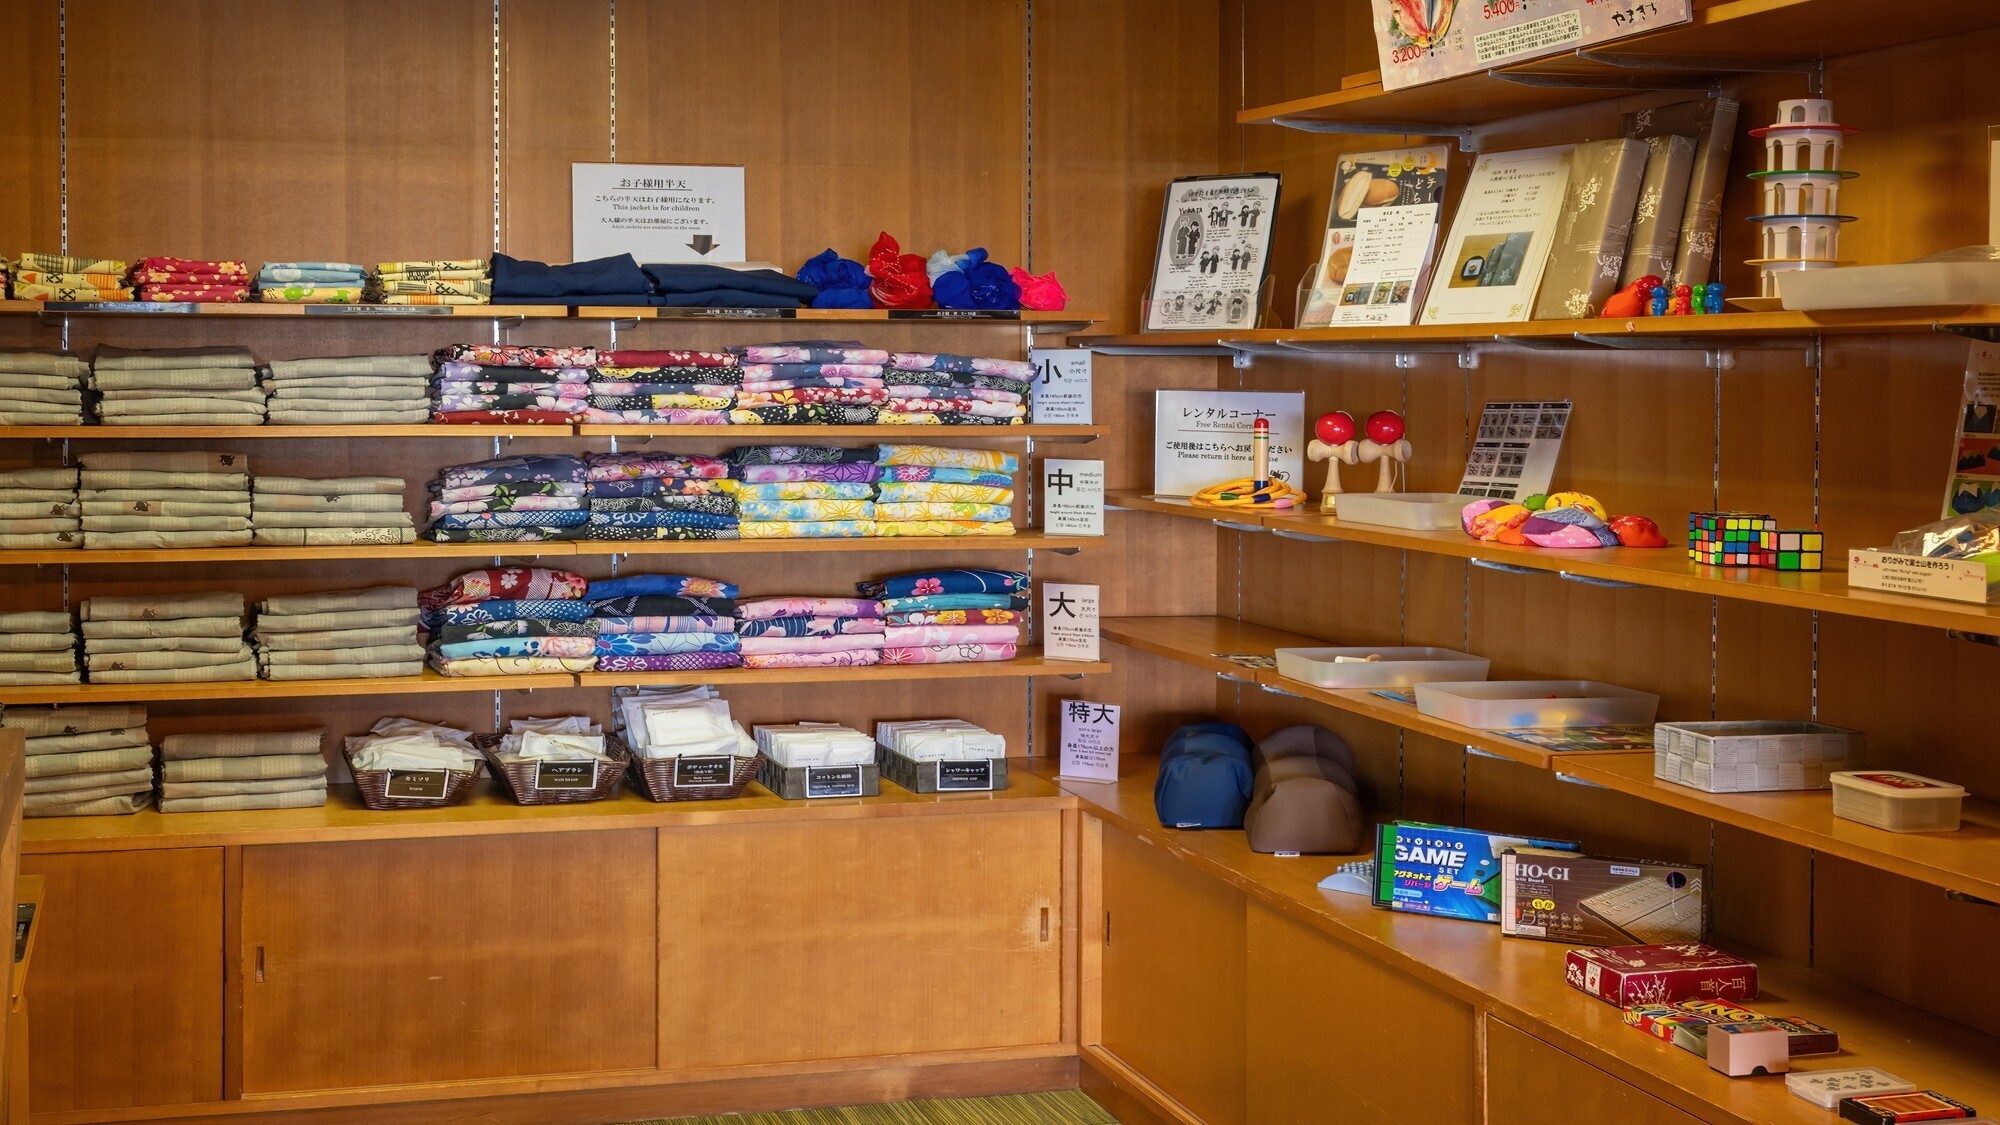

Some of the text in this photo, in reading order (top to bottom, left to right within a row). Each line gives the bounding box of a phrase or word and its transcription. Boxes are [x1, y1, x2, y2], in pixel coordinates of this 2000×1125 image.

[620, 178, 687, 189] お子様用半天
[595, 195, 715, 204] こちらの半天はお子様用になります。
[601, 217, 708, 225] 大人様の半天はお部屋にございます。
[1036, 358, 1063, 385] 小
[1183, 408, 1277, 419] レンタルコーナー
[1196, 420, 1212, 428] Free
[1212, 421, 1235, 429] Rental
[1166, 441, 1293, 454] ご使用後はこちらへお戻ださい
[1178, 451, 1200, 459] Please
[1200, 453, 1223, 461] return
[1048, 468, 1073, 496] 中
[1049, 591, 1076, 618] 大
[1068, 701, 1115, 726] 特大
[1394, 844, 1468, 868] GAME
[1438, 866, 1460, 875] SET
[1433, 874, 1485, 896] ゲーム
[1681, 1001, 1765, 1021] UNO
[1623, 1012, 1642, 1024] UNO
